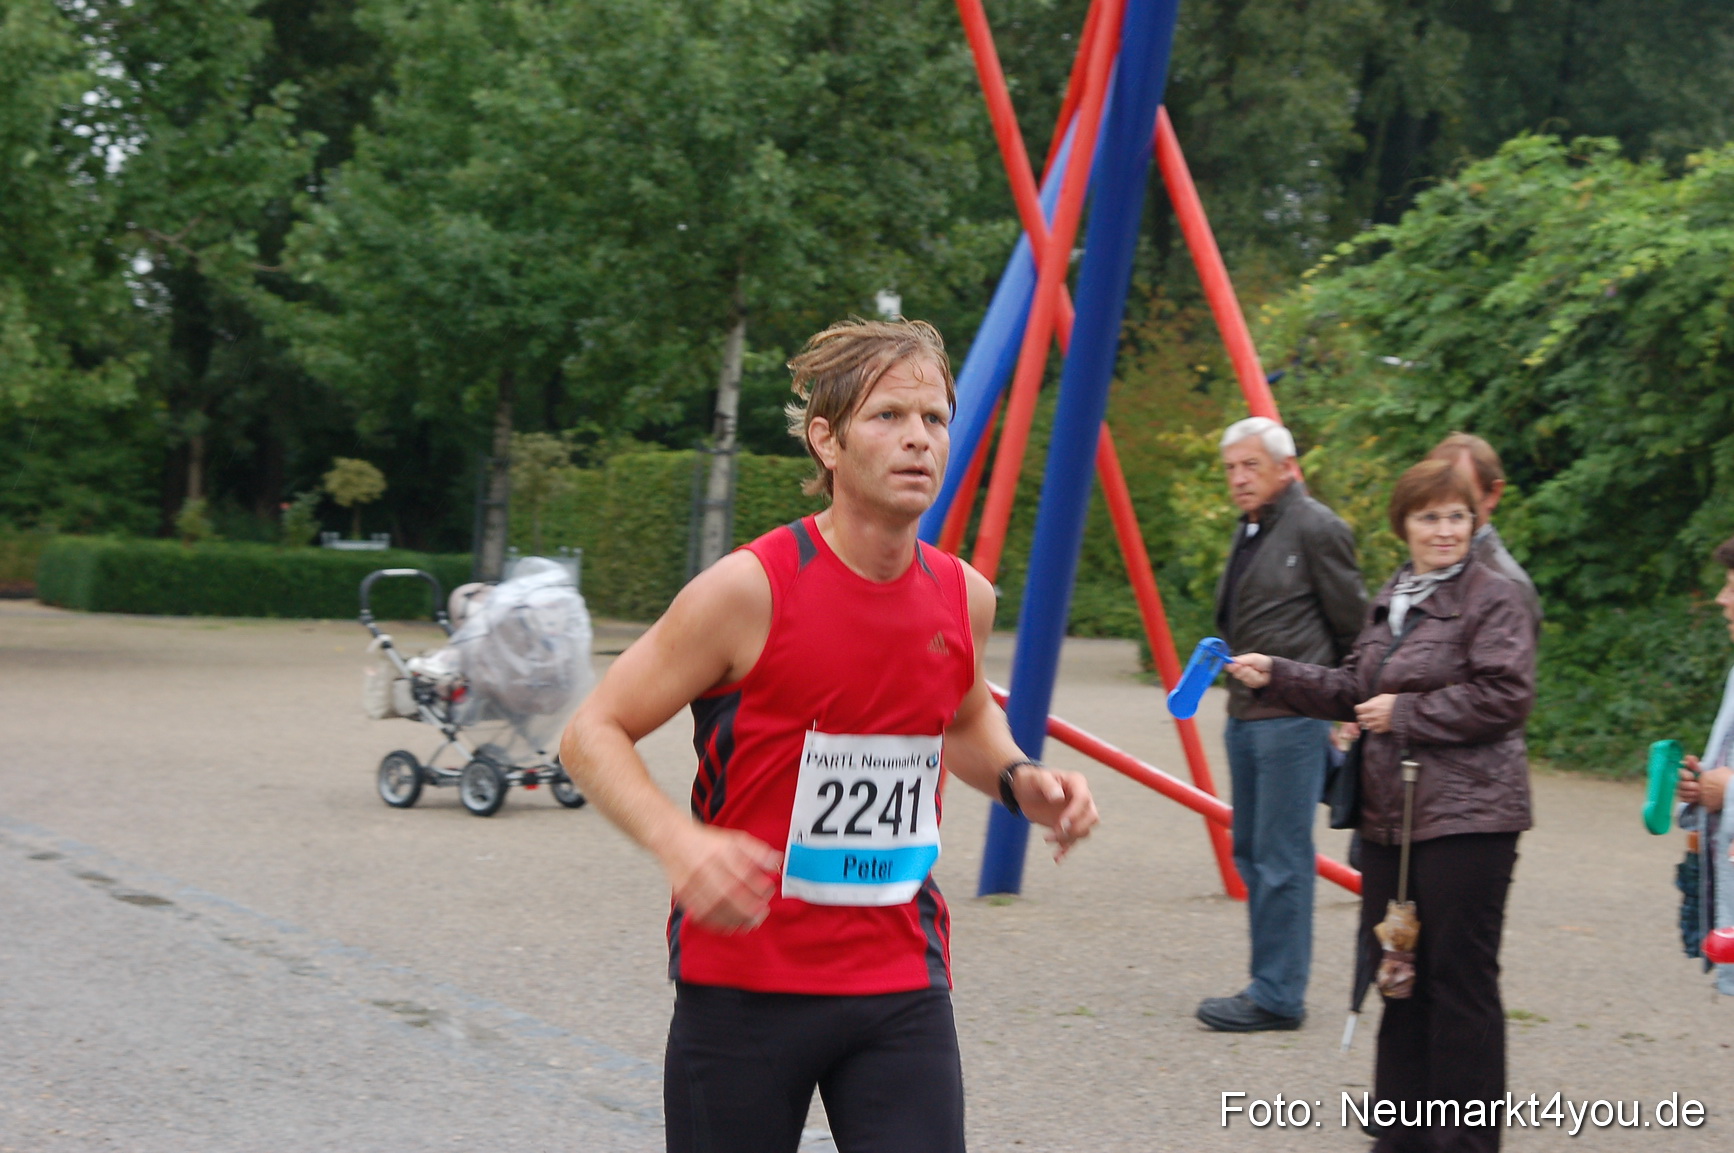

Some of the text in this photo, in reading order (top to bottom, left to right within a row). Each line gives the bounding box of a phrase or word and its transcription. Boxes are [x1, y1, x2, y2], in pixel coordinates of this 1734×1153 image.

[806, 752, 921, 770] PARTL Neumarkt
[810, 777, 922, 837] 2241
[843, 854, 893, 880] Peter
